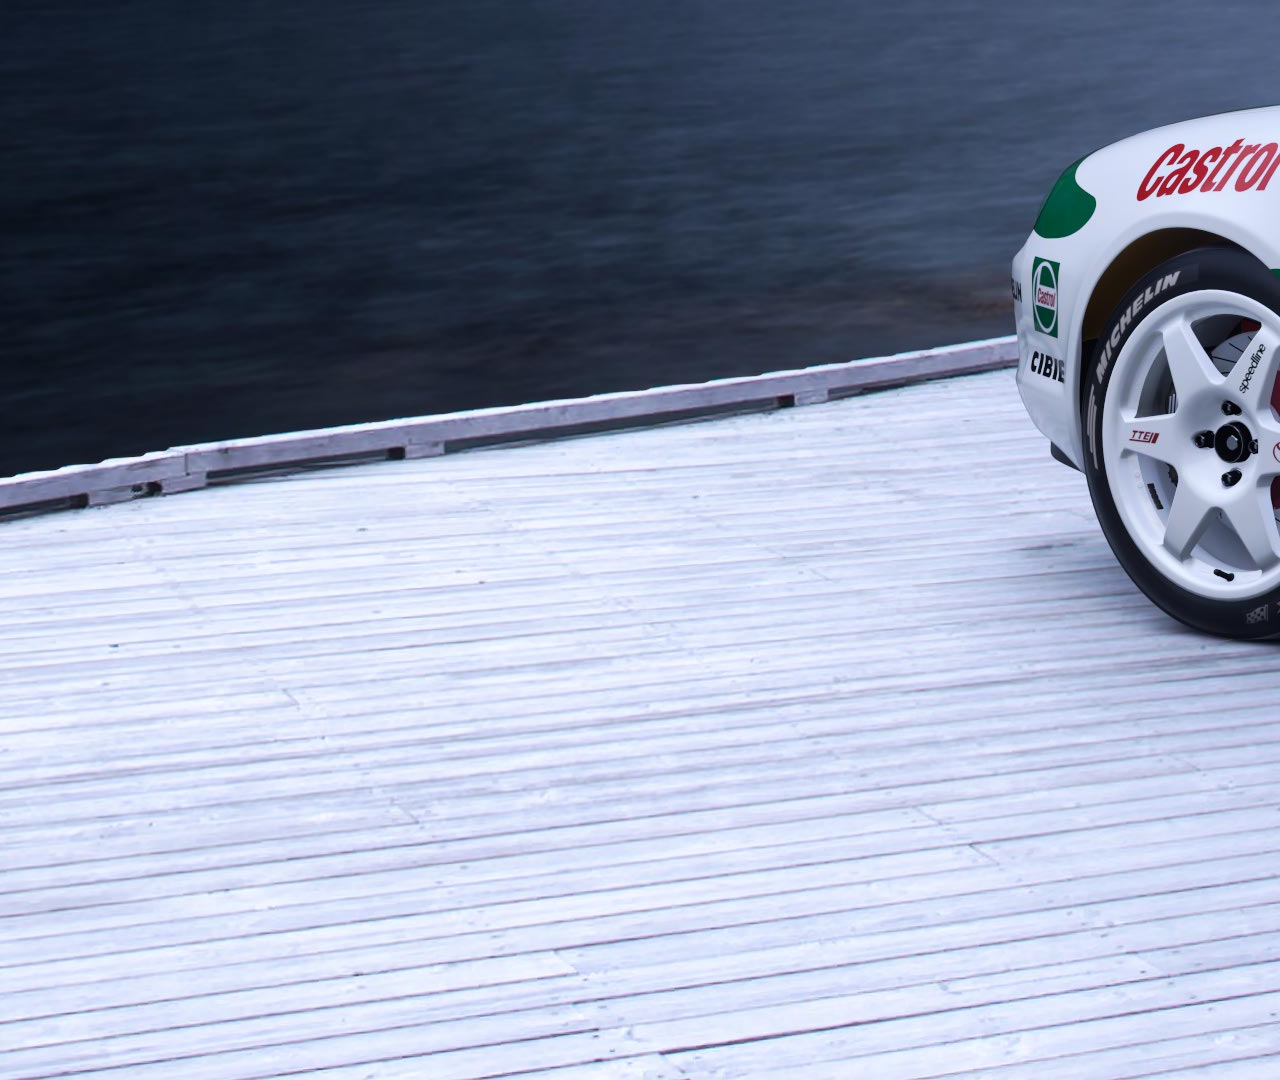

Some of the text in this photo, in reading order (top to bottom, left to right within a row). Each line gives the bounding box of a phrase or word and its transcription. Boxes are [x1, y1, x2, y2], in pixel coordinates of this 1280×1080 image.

[1037, 287, 1056, 308] Castrol
[1096, 271, 1181, 385] MICHELIN
[1239, 343, 1266, 394] speedline
